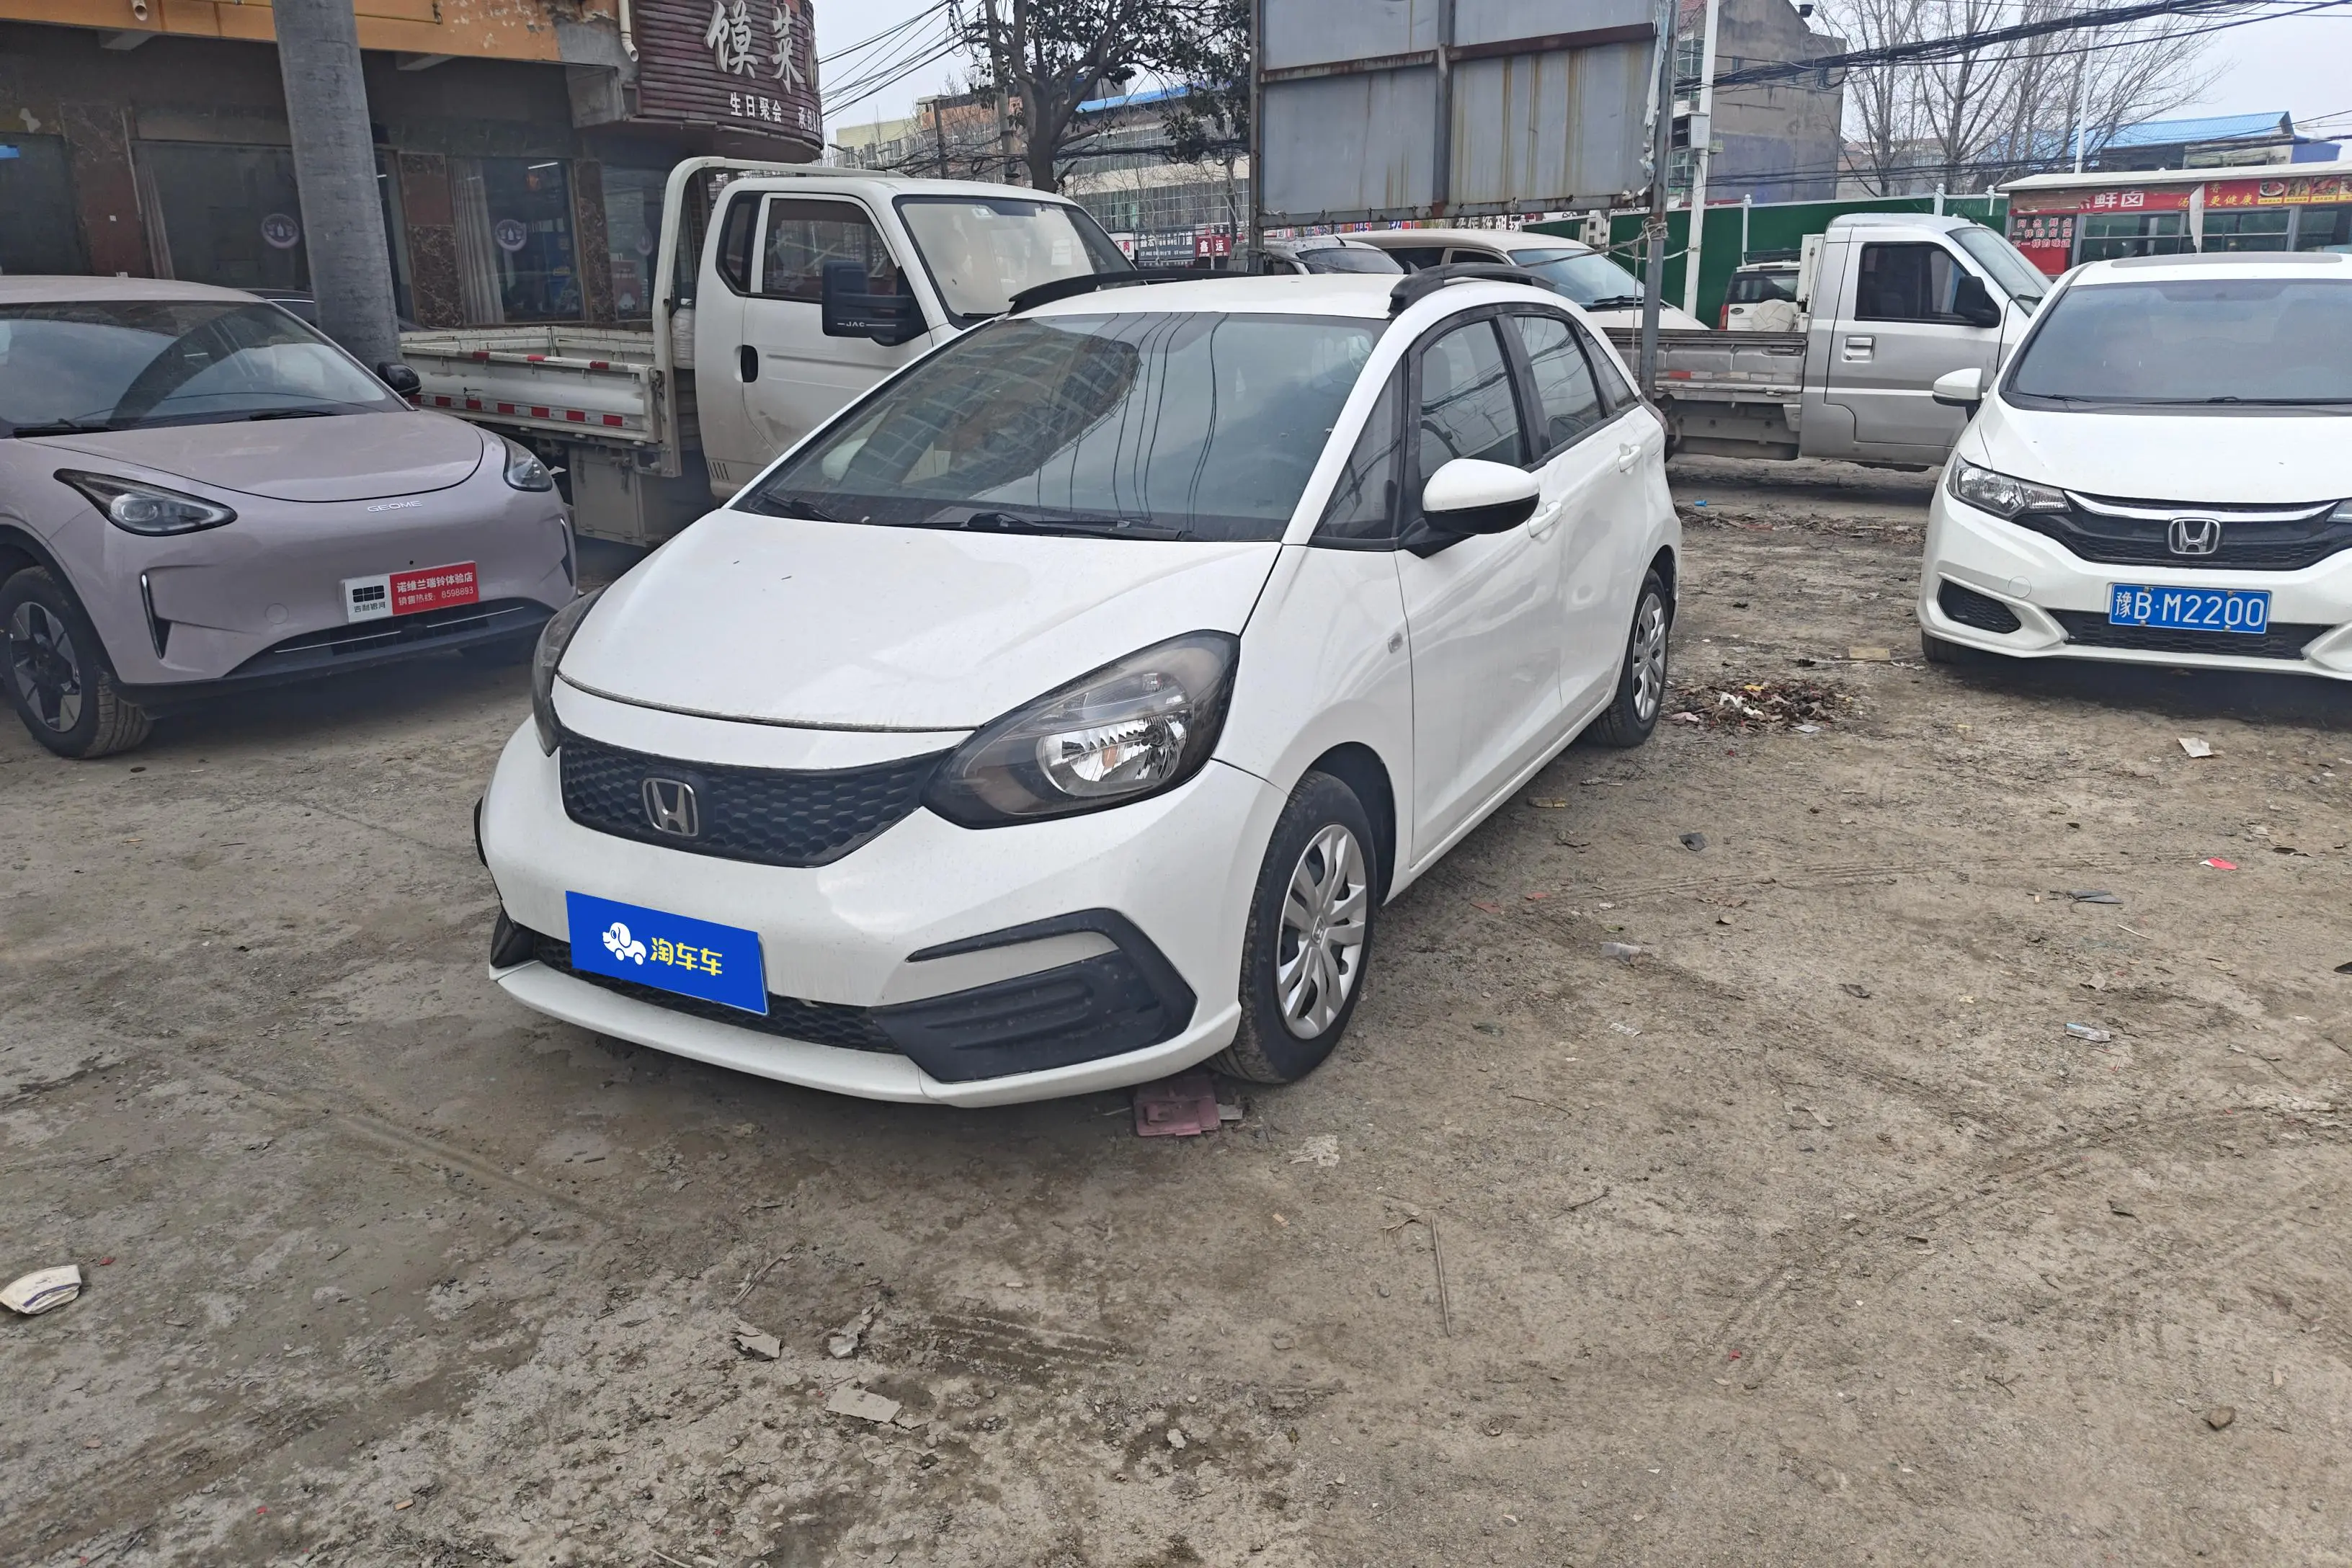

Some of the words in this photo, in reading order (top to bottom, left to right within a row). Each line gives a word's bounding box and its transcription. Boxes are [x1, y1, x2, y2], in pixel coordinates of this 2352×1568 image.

[730, 92, 782, 122] 生日聚会
[367, 501, 423, 512] GEOME
[441, 586, 474, 599] 8598893
